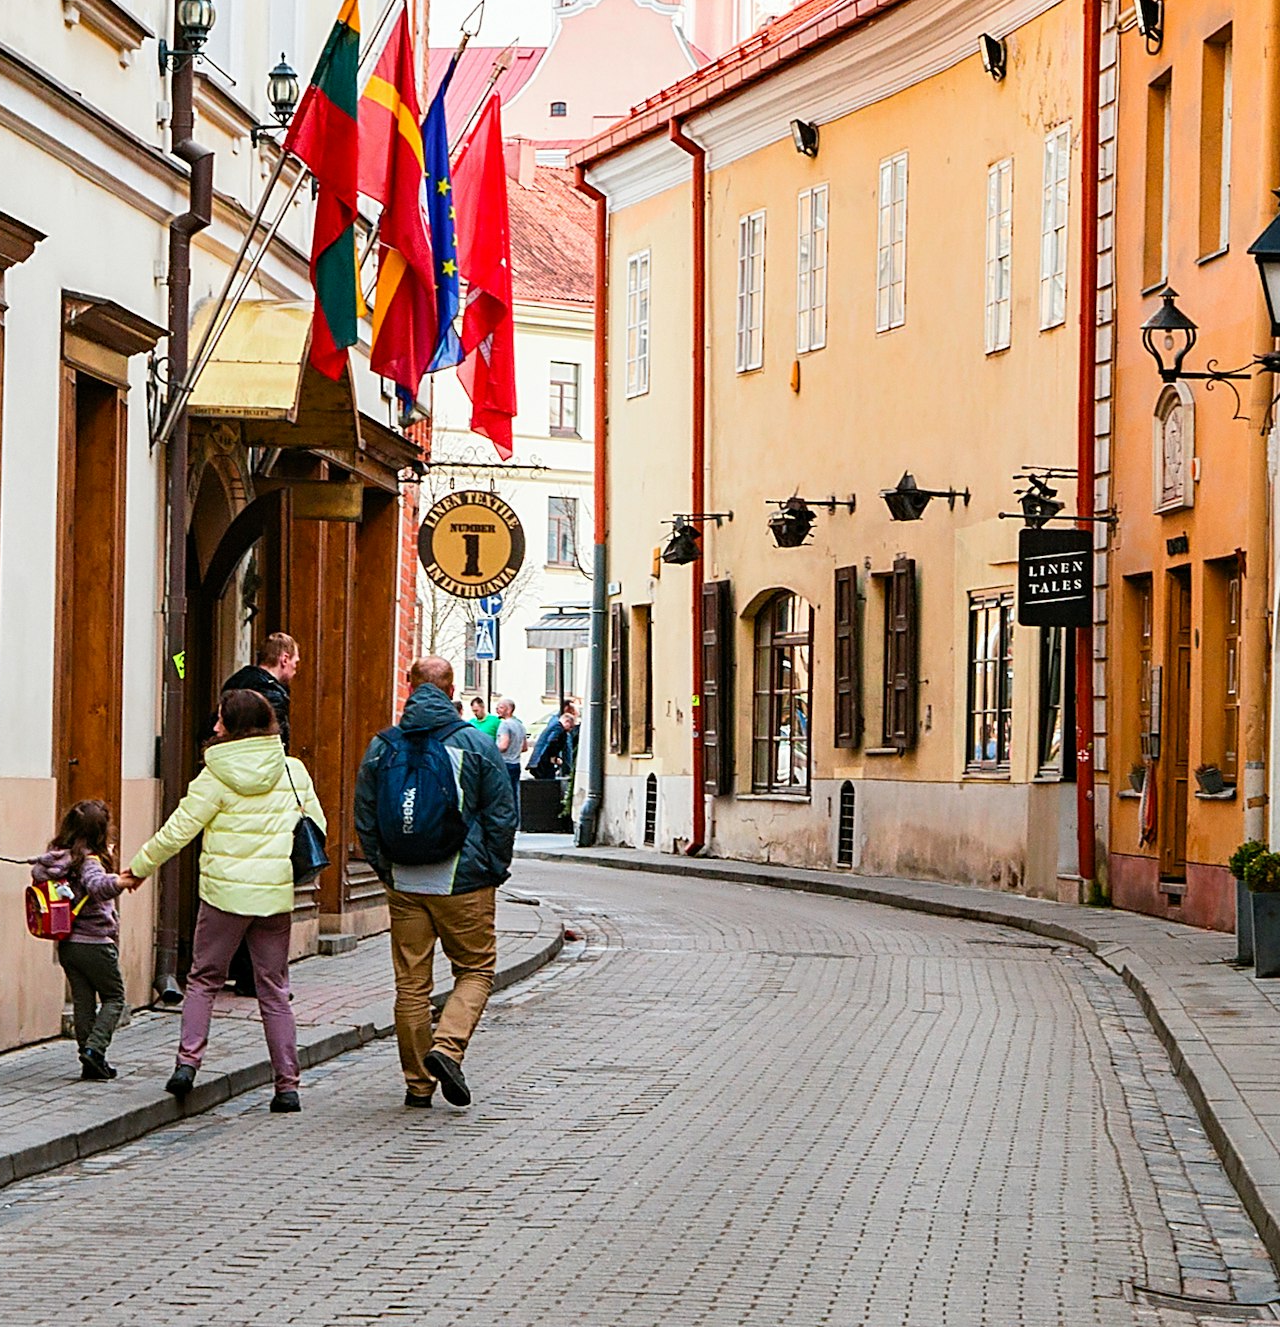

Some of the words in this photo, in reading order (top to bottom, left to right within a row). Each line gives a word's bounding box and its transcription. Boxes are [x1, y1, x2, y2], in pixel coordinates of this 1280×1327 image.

[425, 494, 463, 529] LINEN
[465, 491, 519, 530] TEXTILE
[450, 523, 496, 533] NUMBER
[461, 534, 483, 577] 1
[1028, 560, 1084, 578] LINEN
[426, 562, 443, 581] IN
[442, 566, 517, 597] LITHUANIA
[1028, 578, 1083, 595] TALES
[402, 787, 417, 835] Reebok
